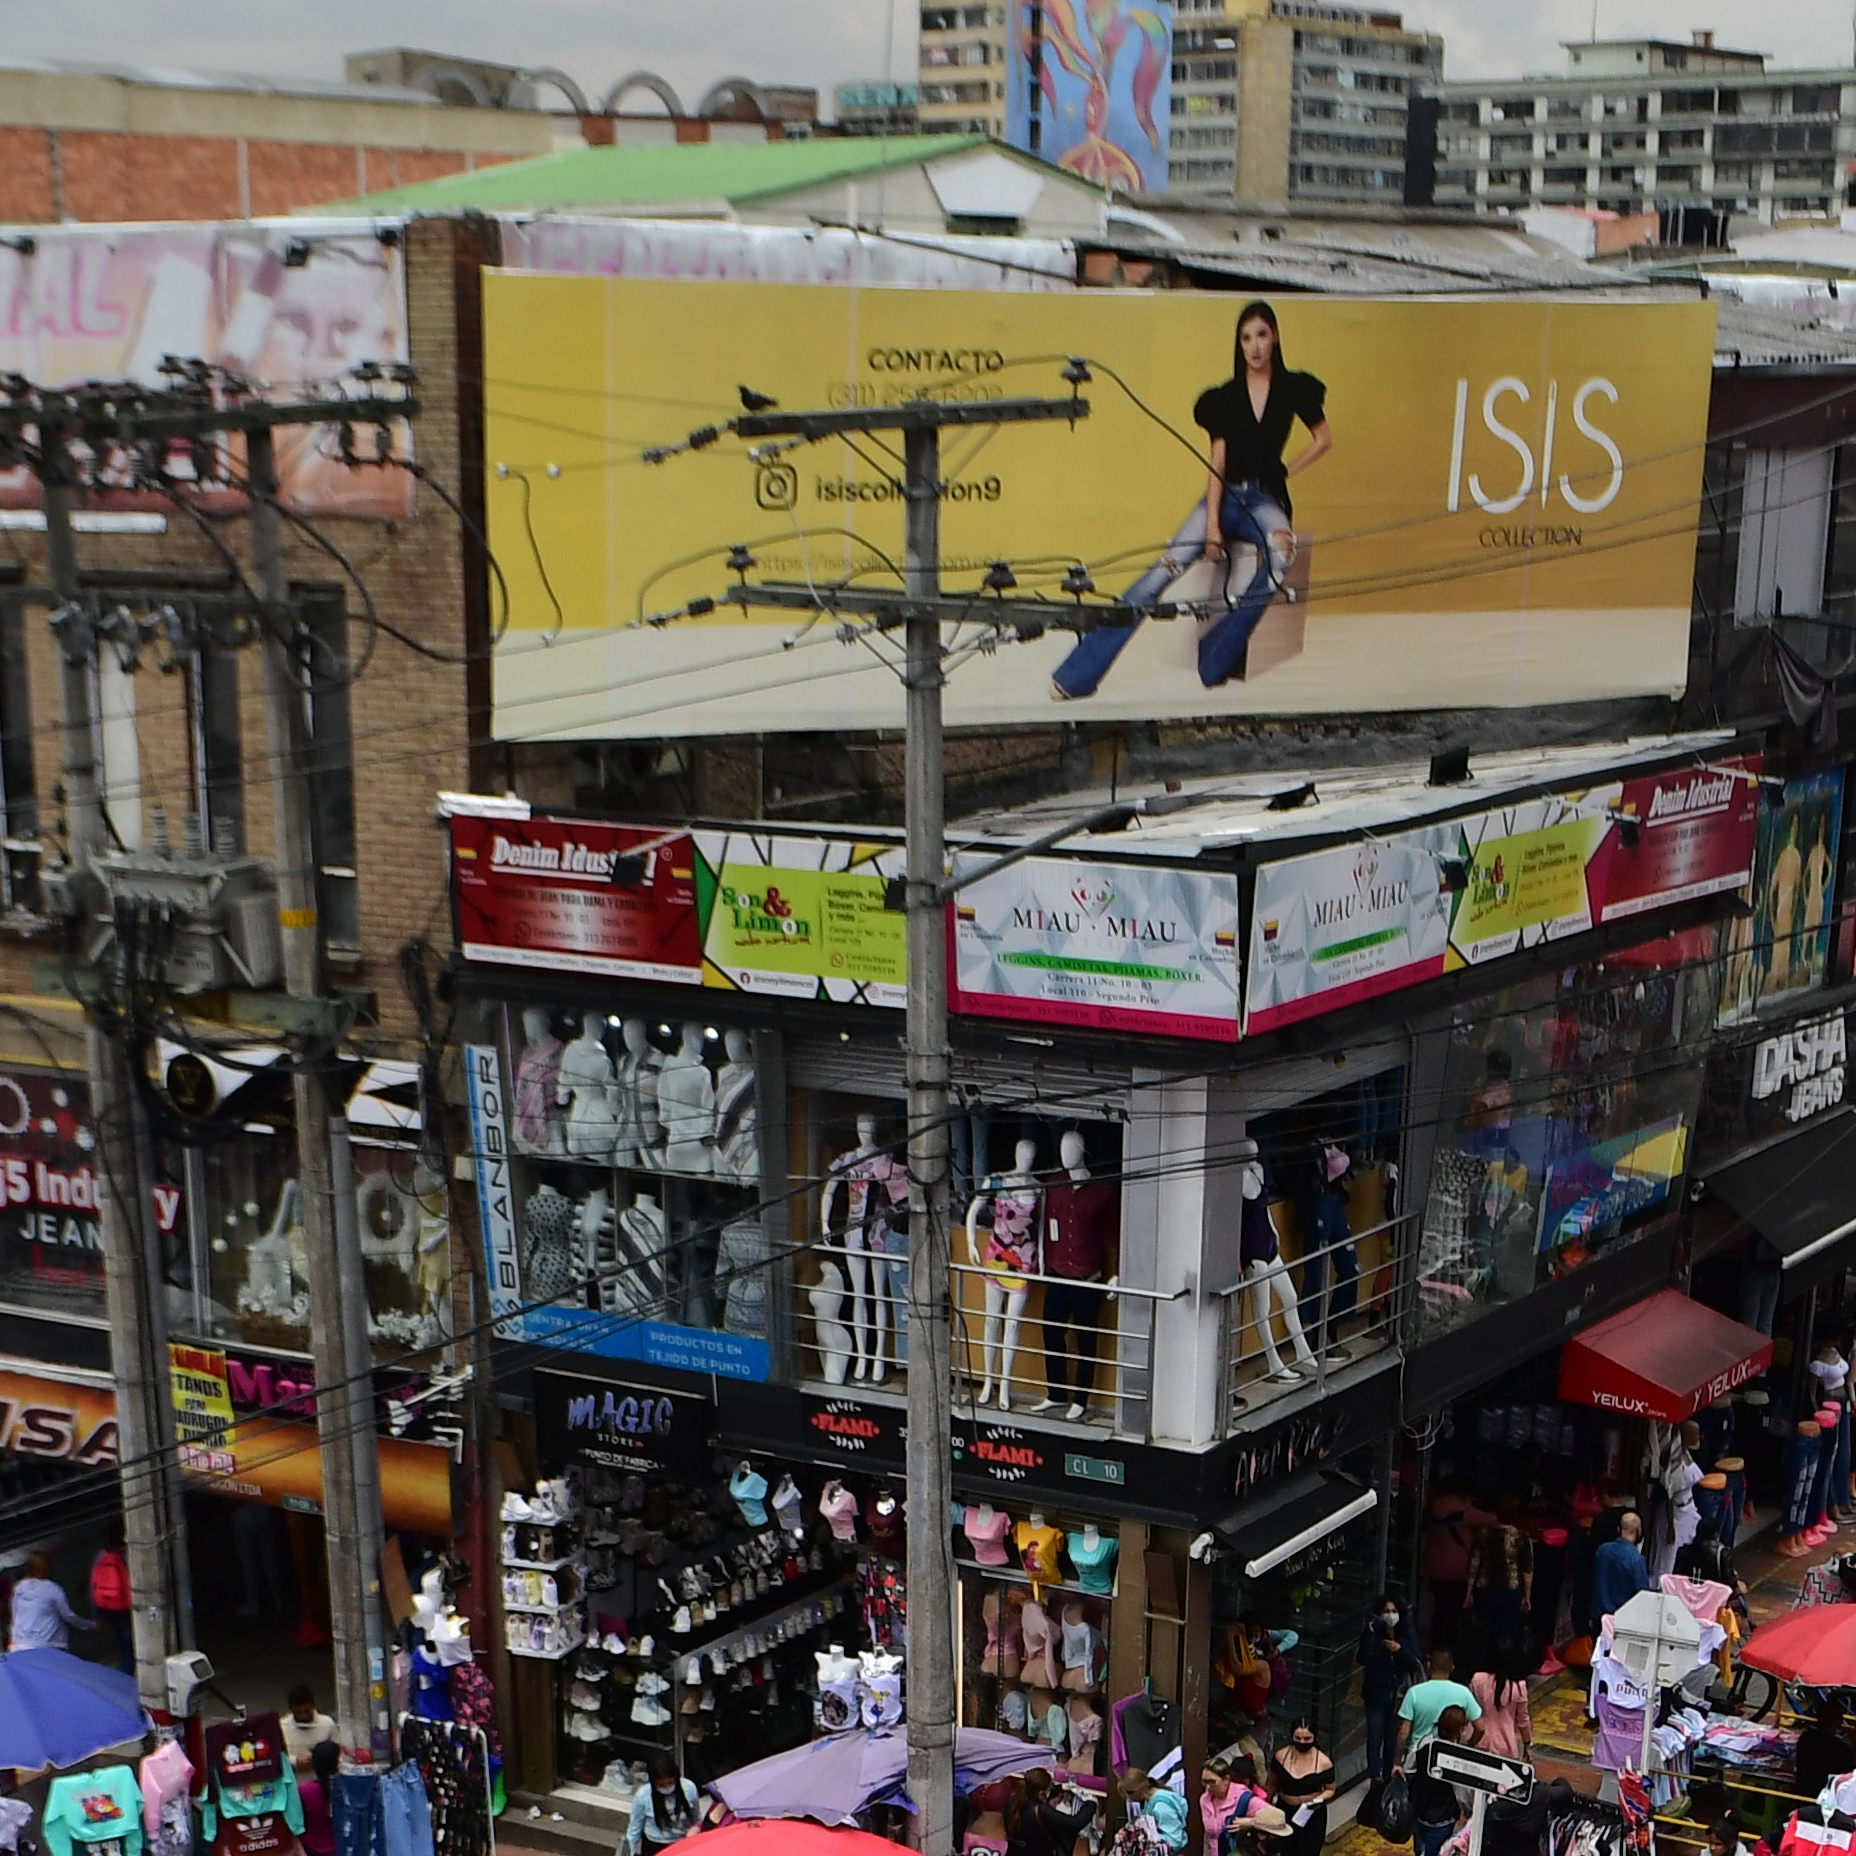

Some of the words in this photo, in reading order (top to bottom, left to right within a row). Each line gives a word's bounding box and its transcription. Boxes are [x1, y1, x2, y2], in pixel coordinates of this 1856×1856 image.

[868, 349, 1004, 373] CONTACTO
[1446, 376, 1626, 515] ISIS
[815, 476, 1002, 502] isiscollion9
[1478, 526, 1585, 550] COLLECTION
[1648, 781, 1688, 818] Denim
[491, 836, 560, 870] Denim
[722, 886, 763, 908] Son
[763, 886, 792, 918] &
[1314, 893, 1357, 928] MIAU
[1367, 880, 1410, 913] MIAU
[733, 908, 813, 936] Limon
[1012, 906, 1082, 934] MIAU
[1107, 915, 1177, 944] MIAU
[1752, 1007, 1847, 1100] DASHA
[1785, 1066, 1846, 1124] JEANS
[479, 1053, 518, 1291] BLANBOR
[35, 1161, 184, 1232] Induy
[18, 1212, 105, 1251] JEAN
[650, 1331, 724, 1354] PRODUCTOS
[726, 1343, 743, 1357] EN
[648, 1349, 690, 1366] TEJIDO
[692, 1355, 708, 1371] DE
[709, 1359, 751, 1376] PUNTO
[567, 1390, 674, 1438] MAGIC
[817, 1413, 874, 1438] FLAMI
[597, 1432, 634, 1448] STORE
[977, 1439, 1036, 1468] FLAMI
[585, 1448, 612, 1464] PUNTO
[612, 1451, 625, 1465] DE
[625, 1453, 660, 1471] FABRICA
[1073, 1461, 1089, 1476] CL
[1103, 1464, 1119, 1480] 10
[239, 1837, 280, 1853] adidas
